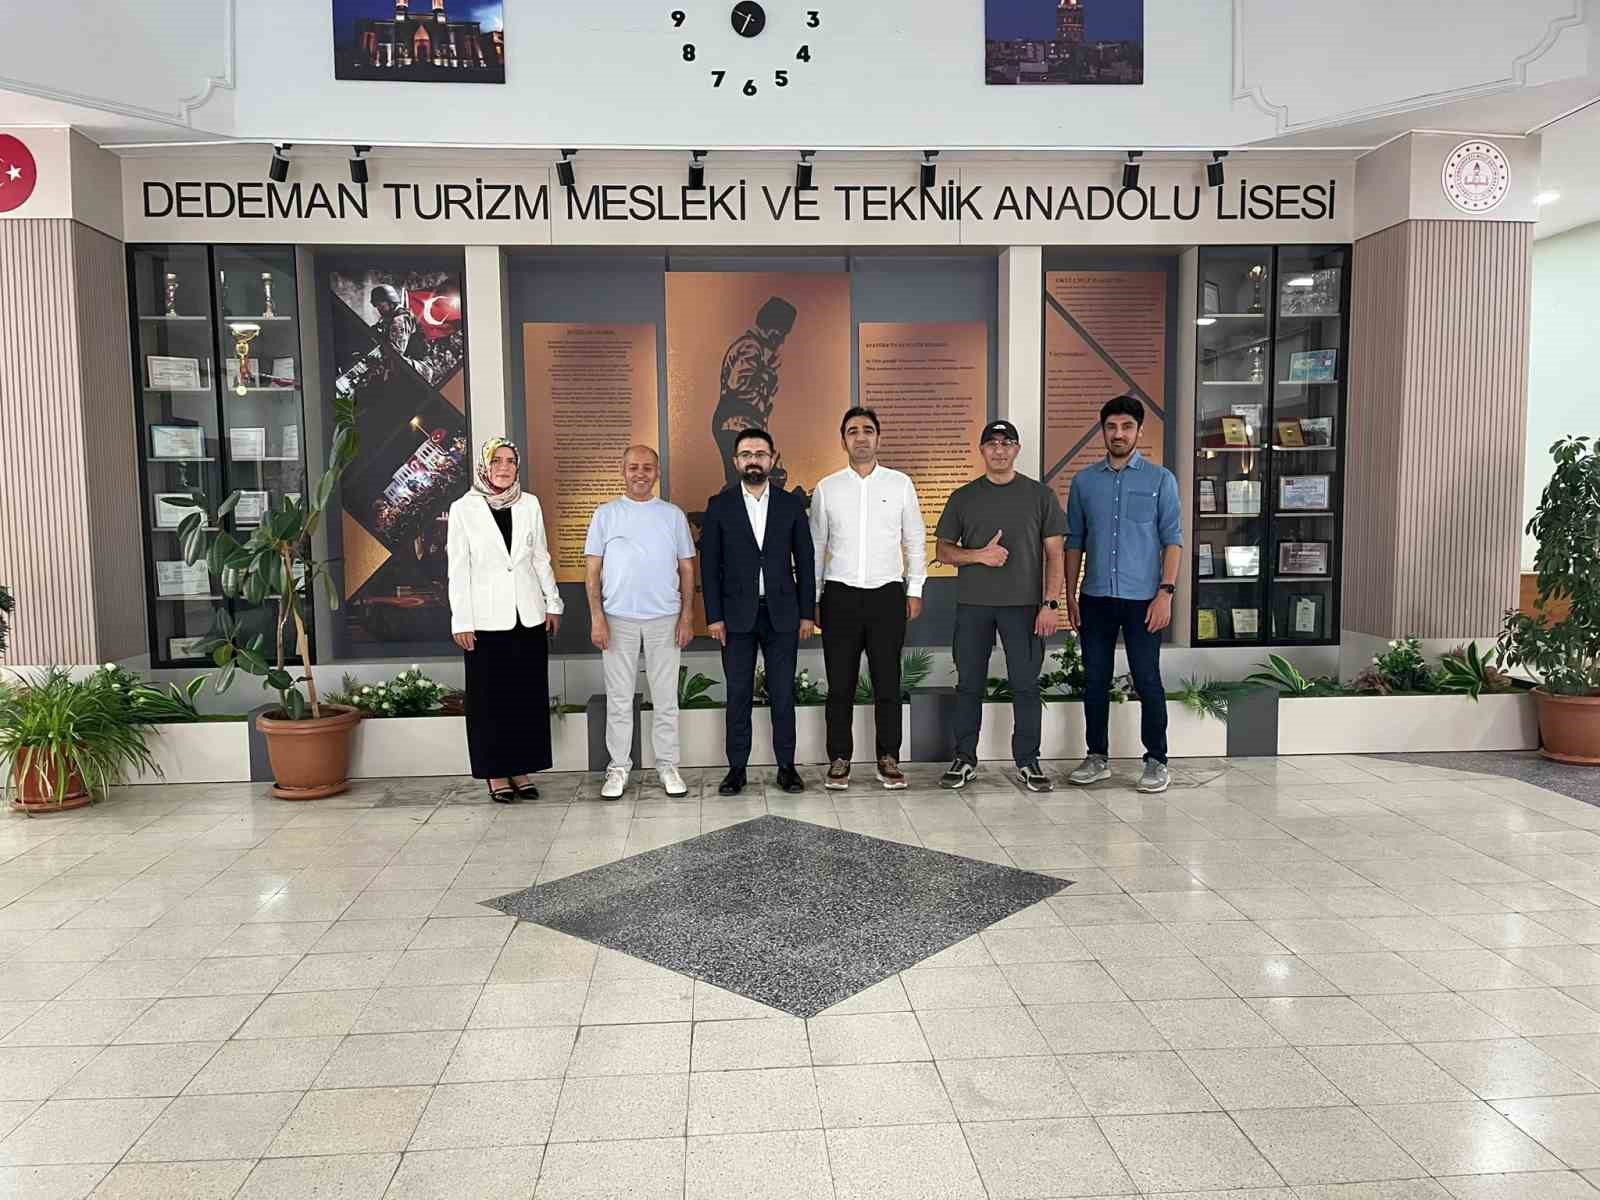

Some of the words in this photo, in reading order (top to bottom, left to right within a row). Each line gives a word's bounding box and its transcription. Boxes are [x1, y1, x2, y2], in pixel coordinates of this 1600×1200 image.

[671, 10, 686, 28] 9
[806, 10, 820, 28] 3
[682, 43, 696, 62] 8
[796, 45, 811, 63] 4
[711, 70, 726, 88] 7
[775, 70, 788, 87] 5
[742, 79, 757, 97] 6
[143, 182, 368, 219] DEDEMAN
[383, 178, 549, 220] TURİZM
[566, 180, 746, 221] MESLEKİ
[762, 186, 819, 221] VE
[835, 180, 983, 221] TEKNİK
[994, 186, 1200, 221] ANADOLU
[1217, 180, 1336, 220] LİSESİ
